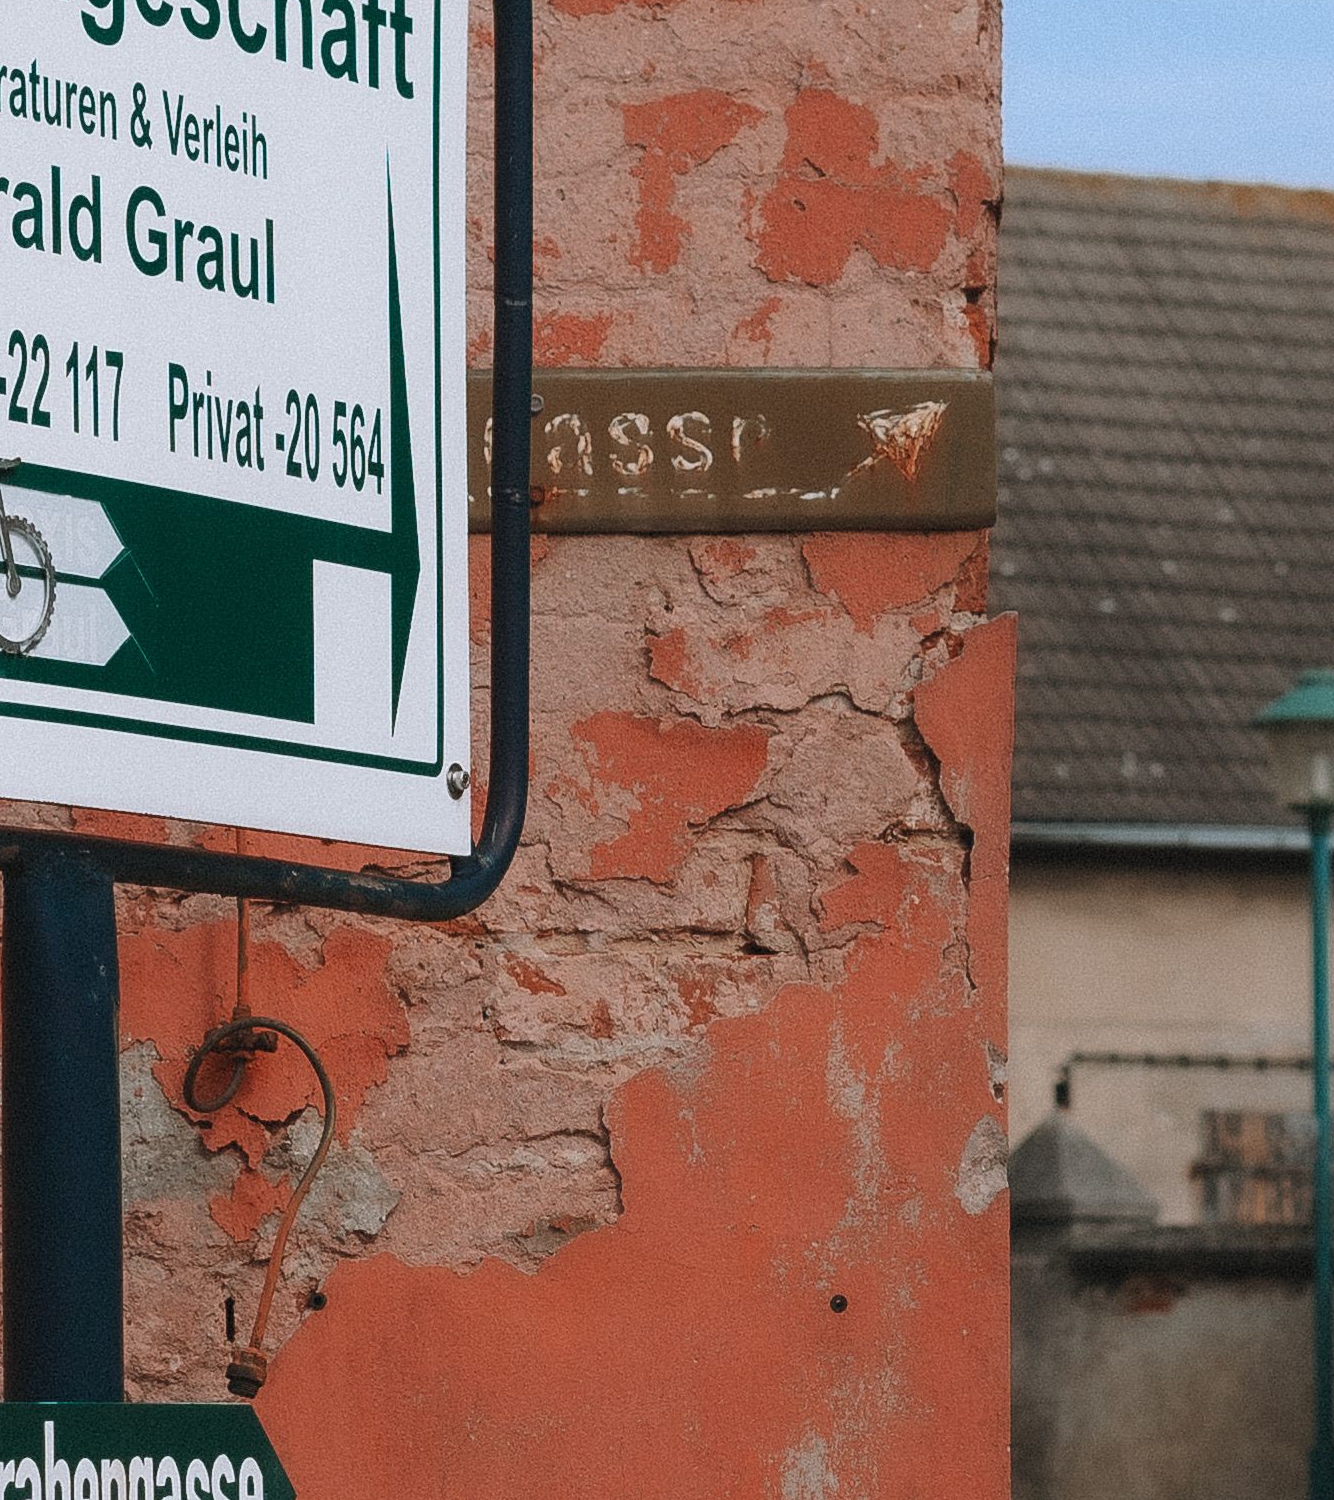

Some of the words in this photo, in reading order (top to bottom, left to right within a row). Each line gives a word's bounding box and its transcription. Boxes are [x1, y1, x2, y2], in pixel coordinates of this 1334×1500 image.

[129, 81, 154, 151] &
[161, 88, 269, 181] Verleih
[124, 184, 276, 306] Graul
[64, 340, 125, 443] 117
[167, 361, 266, 473] Privat
[331, 399, 386, 496] 564
